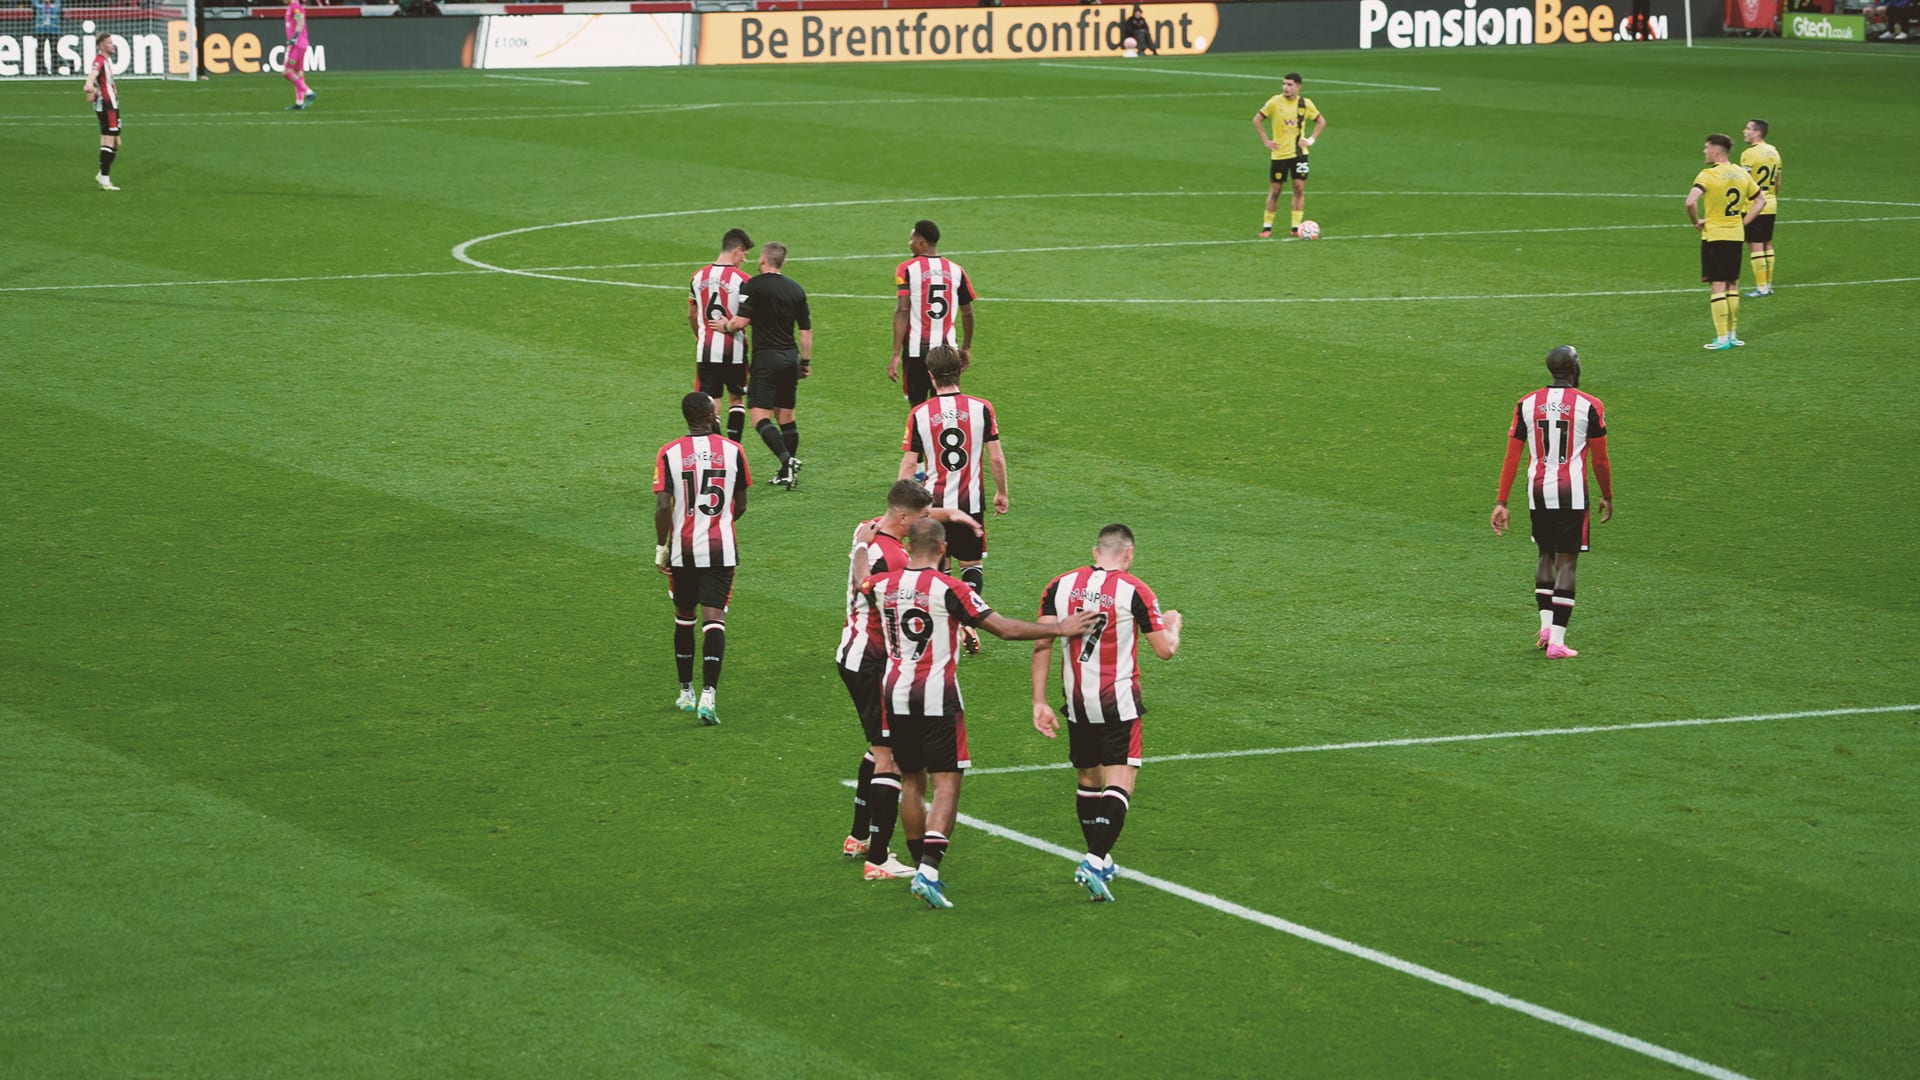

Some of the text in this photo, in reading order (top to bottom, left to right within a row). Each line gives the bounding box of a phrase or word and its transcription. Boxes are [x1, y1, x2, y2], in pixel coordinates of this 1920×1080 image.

[742, 8, 1192, 58] Be Brentford confidnt
[1360, 0, 1669, 49] PensionBee.cM
[1296, 162, 1309, 173] 25
[1725, 187, 1740, 216] 2
[706, 291, 729, 322] 6
[926, 284, 948, 319] 5
[939, 428, 968, 472] 8
[1538, 419, 1568, 463] 11
[681, 469, 726, 516] 15
[884, 607, 934, 661] 19
[1076, 607, 1108, 662] 7
